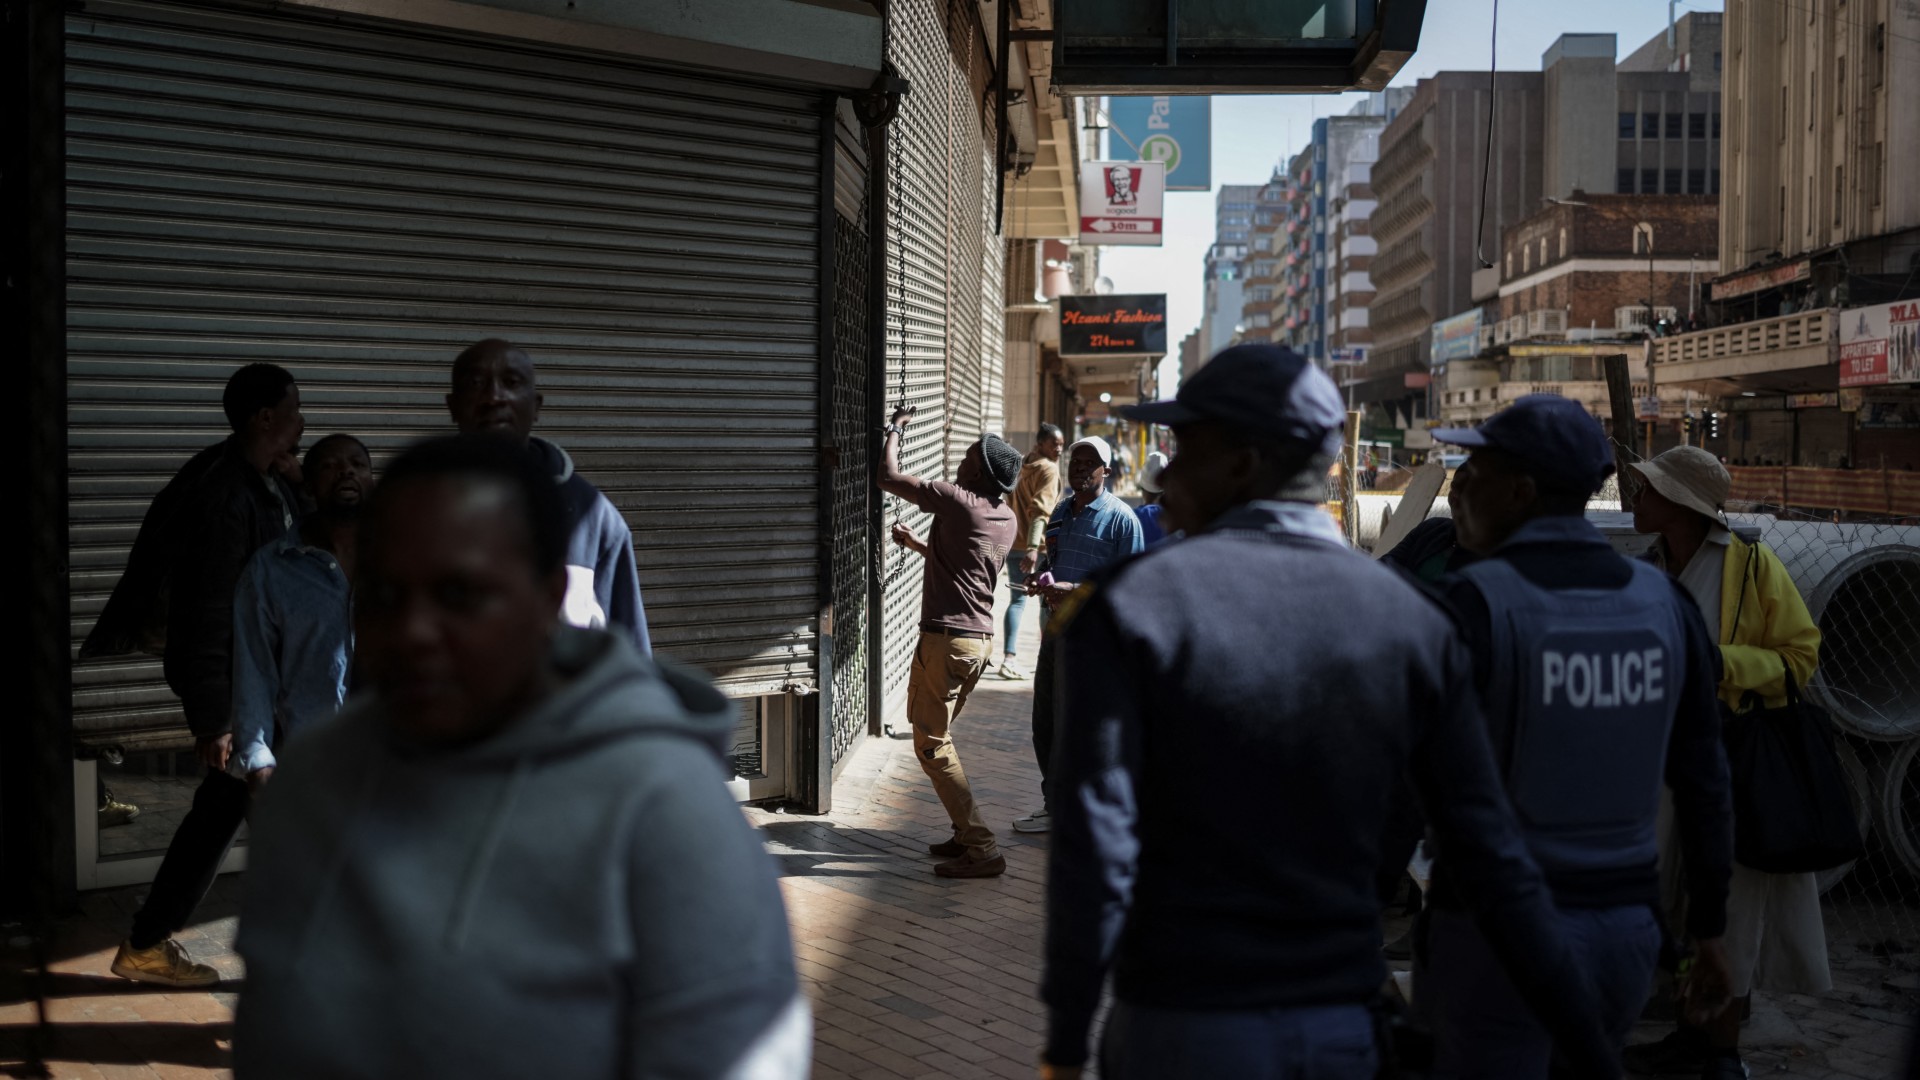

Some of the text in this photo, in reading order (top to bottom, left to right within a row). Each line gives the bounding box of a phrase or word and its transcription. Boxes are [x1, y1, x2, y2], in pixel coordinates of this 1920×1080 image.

[1062, 309, 1163, 324] Mzansi Fashion
[1090, 334, 1110, 346] 274
[1840, 340, 1886, 359] APPARTMENT
[1850, 356, 1874, 373] TO LET
[1542, 648, 1663, 708] POLICE
